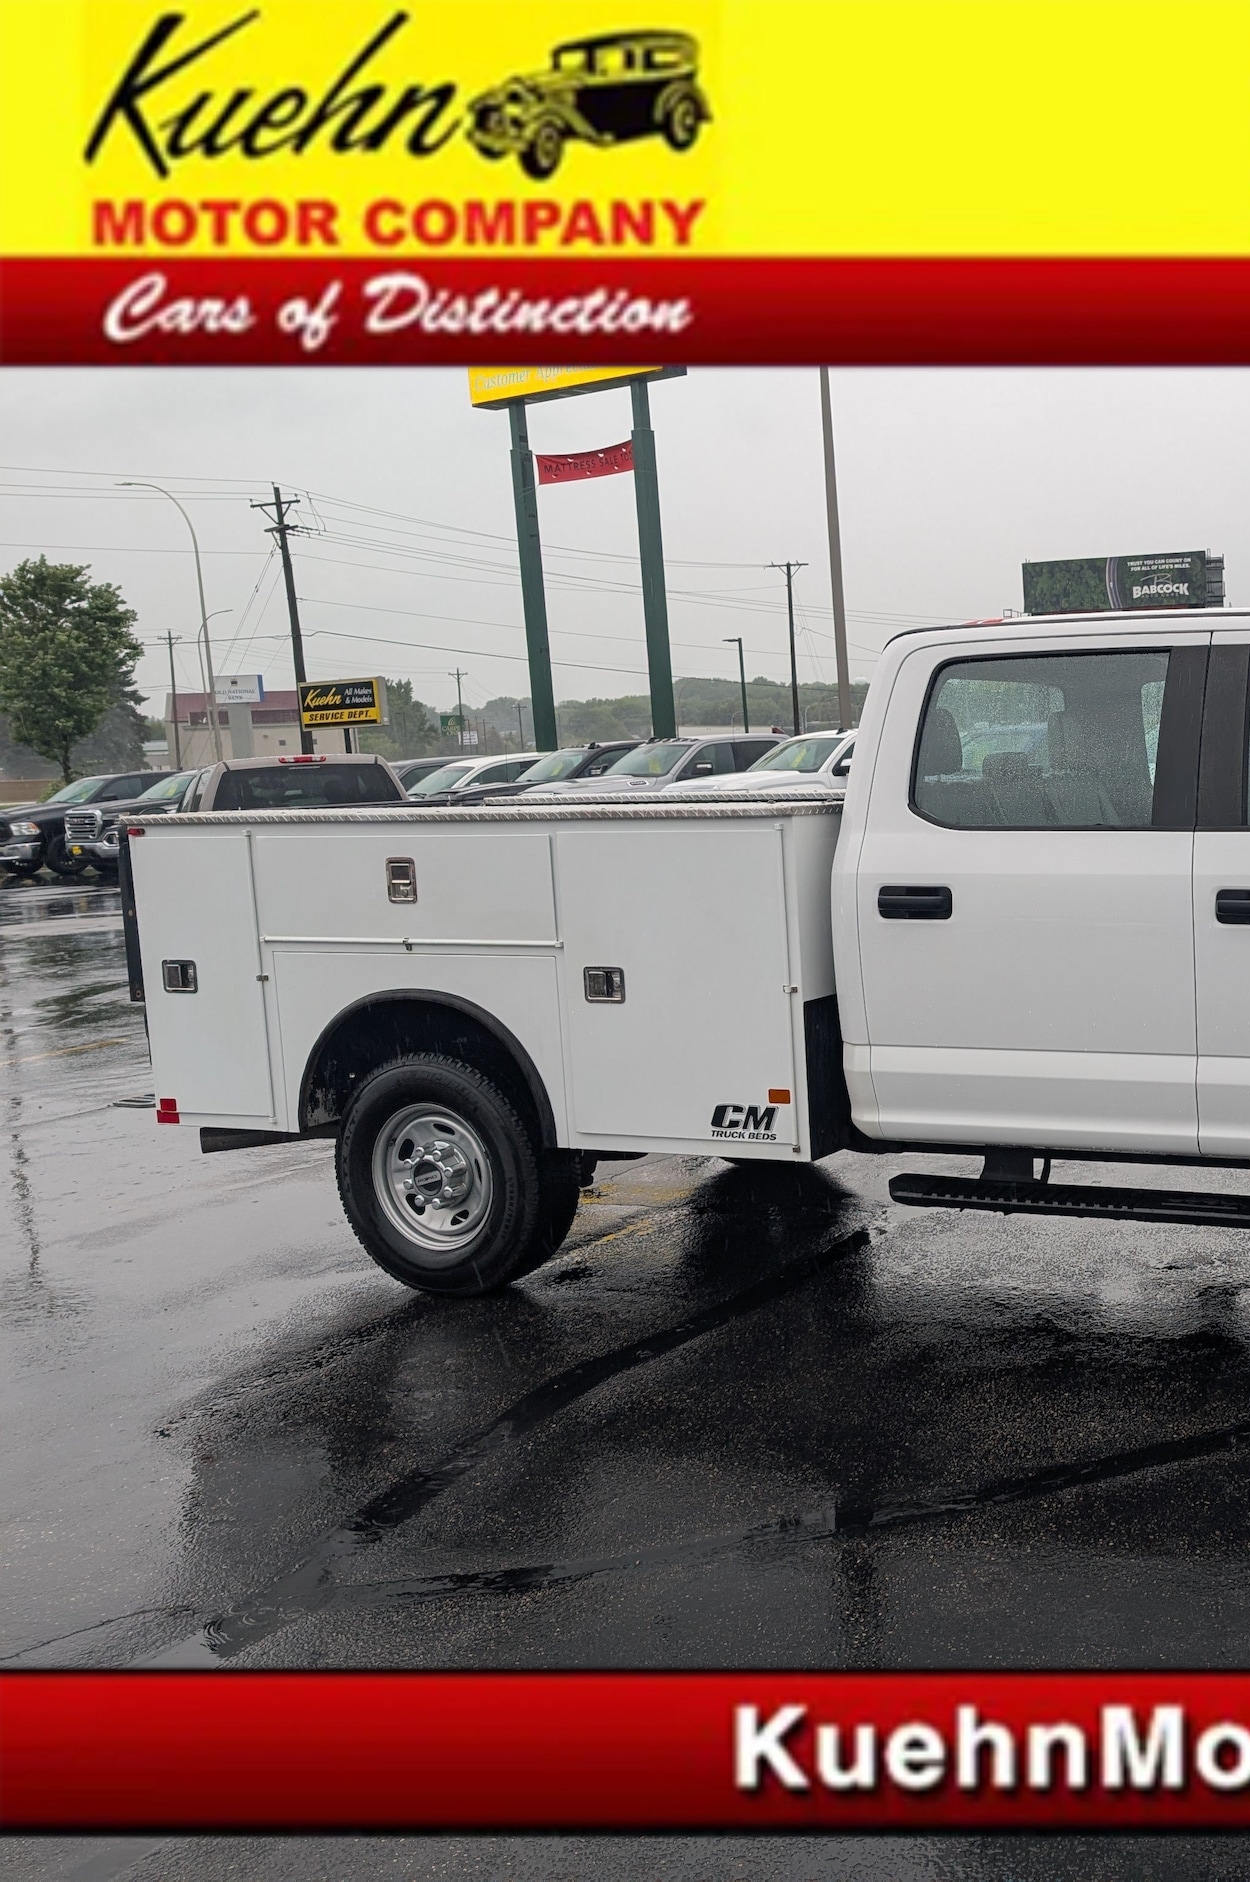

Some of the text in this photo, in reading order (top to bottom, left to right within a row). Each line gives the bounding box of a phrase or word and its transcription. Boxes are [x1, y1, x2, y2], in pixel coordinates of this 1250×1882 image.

[543, 459, 596, 474] MATTRESS
[599, 455, 619, 467] SALE
[1132, 583, 1189, 599] BABCOCK
[303, 687, 342, 708] Kuehn
[343, 687, 373, 696] All Makes
[351, 695, 373, 704] Models
[308, 709, 372, 722] SERVICE DEPT.
[710, 1103, 779, 1132] CM
[711, 1129, 777, 1141] TRUCK BEDS
